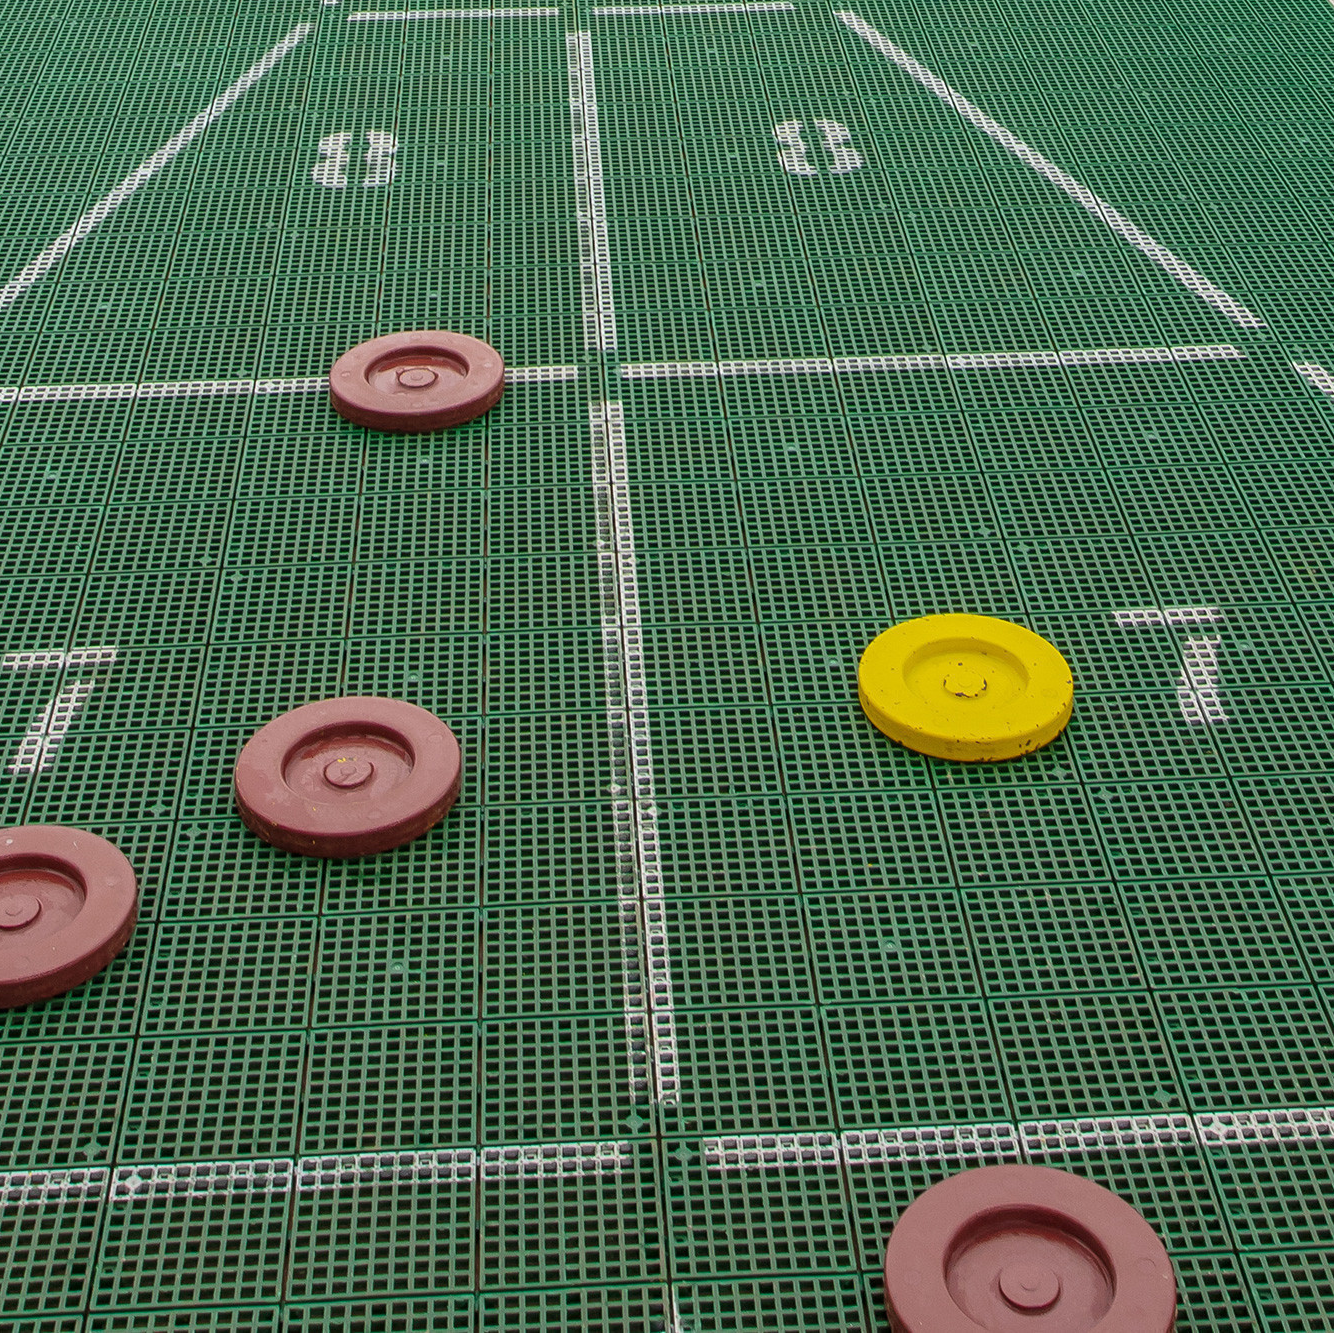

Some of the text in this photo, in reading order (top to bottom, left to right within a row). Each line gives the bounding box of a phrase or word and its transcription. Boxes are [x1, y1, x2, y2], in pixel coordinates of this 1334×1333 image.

[312, 130, 400, 191] 8
[773, 118, 864, 177] 8
[0, 645, 120, 777] 7
[1112, 605, 1226, 727] 7
